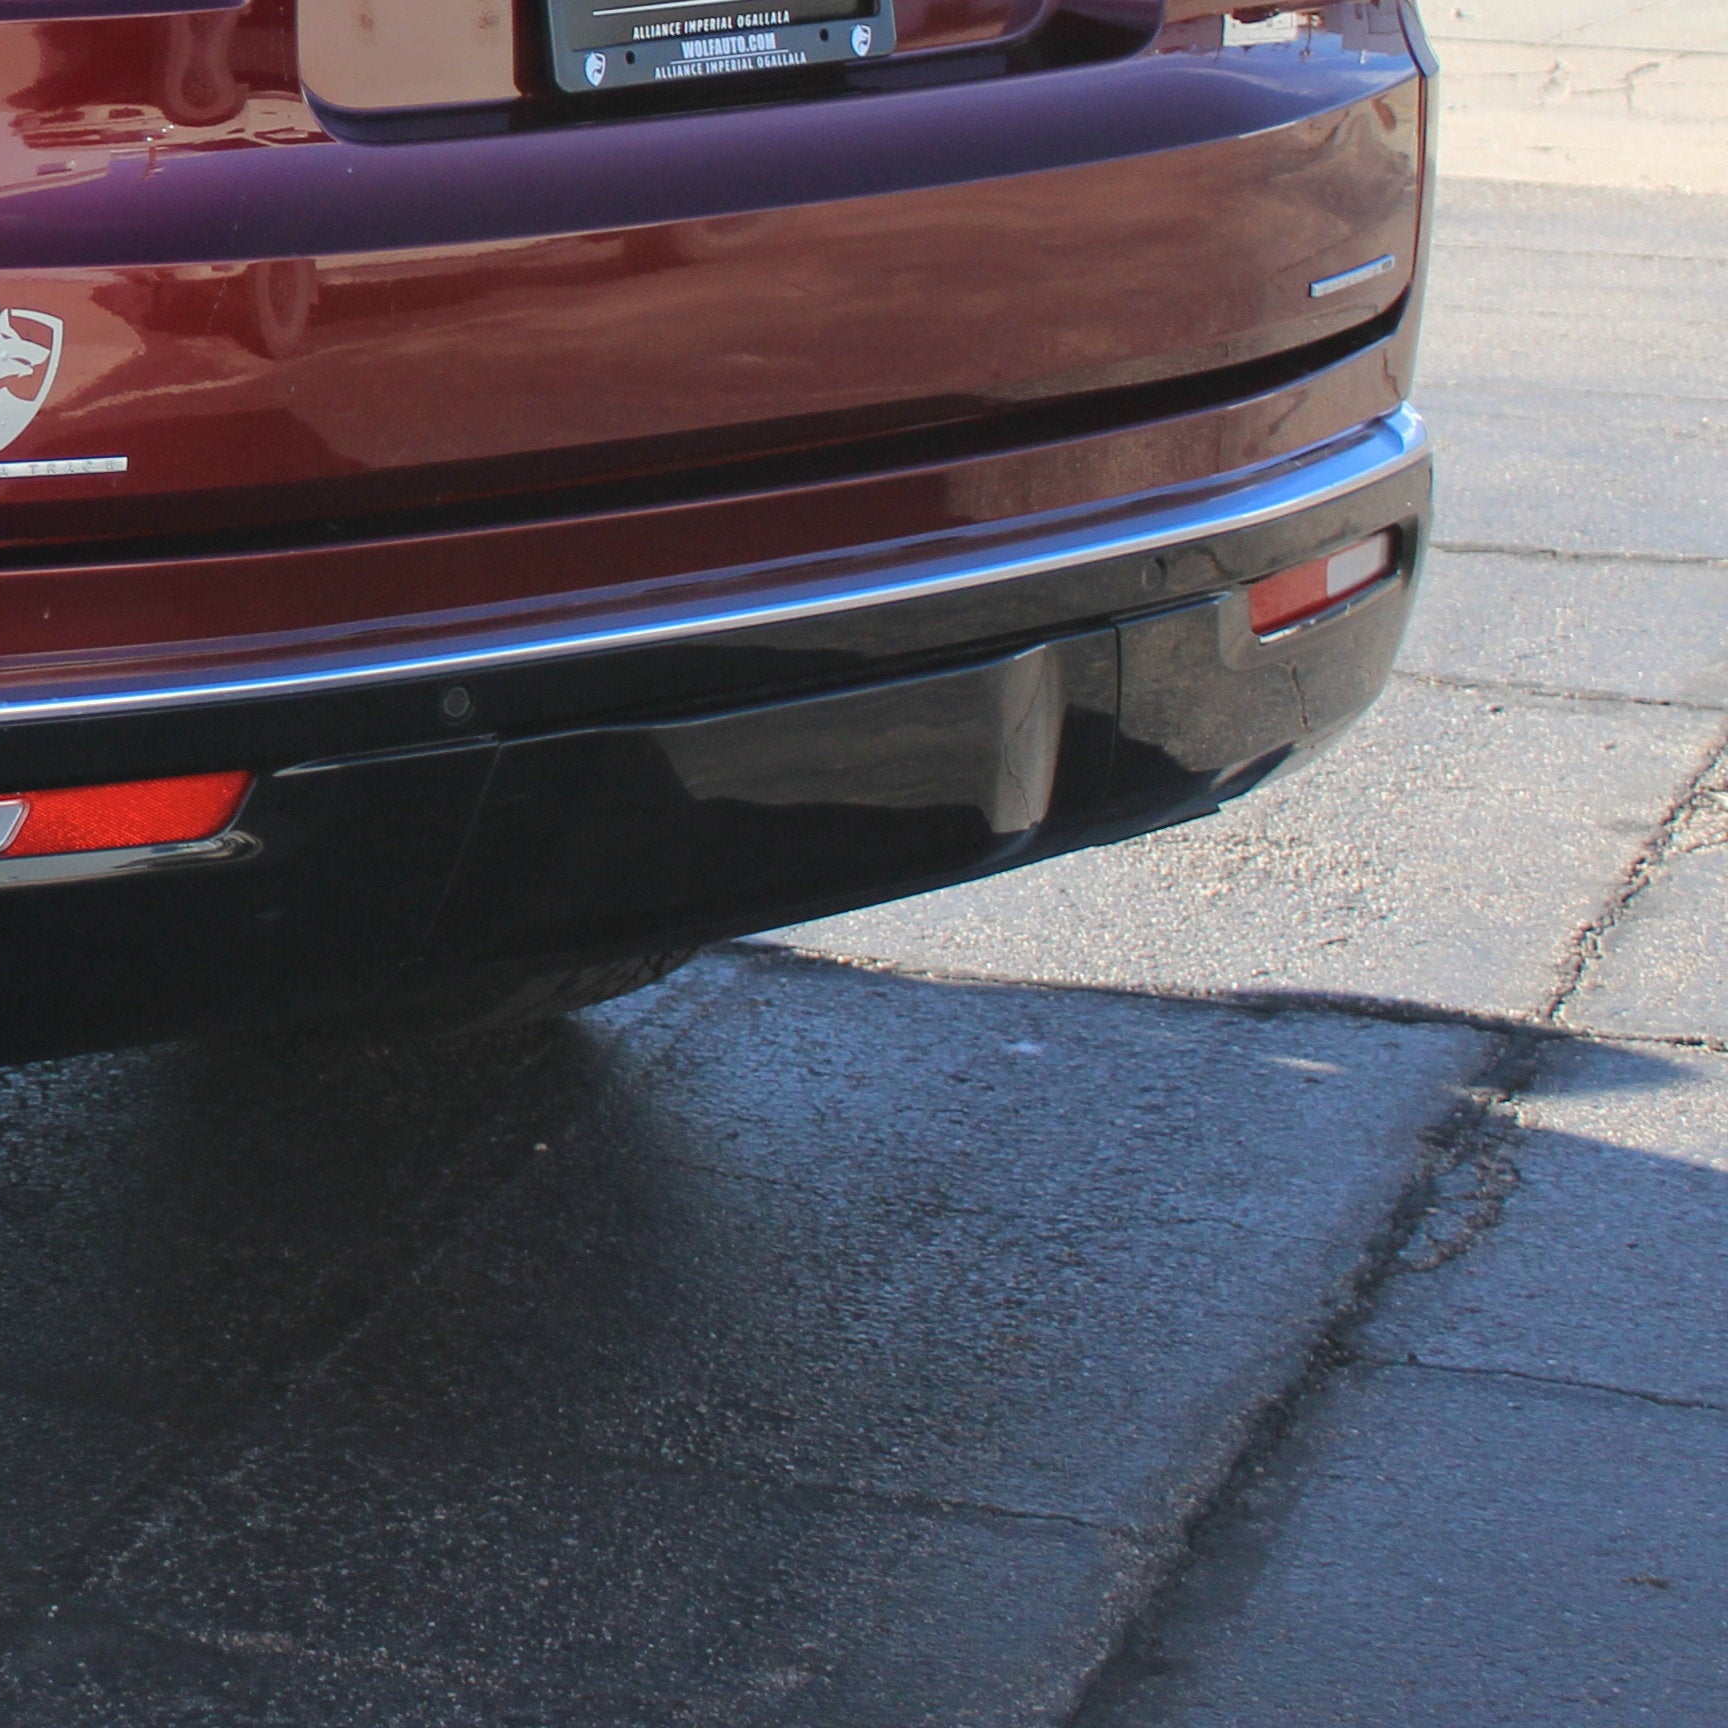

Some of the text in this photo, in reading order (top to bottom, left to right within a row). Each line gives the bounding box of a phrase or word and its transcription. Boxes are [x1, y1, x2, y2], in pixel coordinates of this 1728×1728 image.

[633, 10, 790, 40] ALLIANCE IMPERIAL OGALLALA
[681, 32, 776, 59] WOLFAUTO.COM
[655, 52, 807, 80] ALLIANCE IMPERIAL OGALLALA
